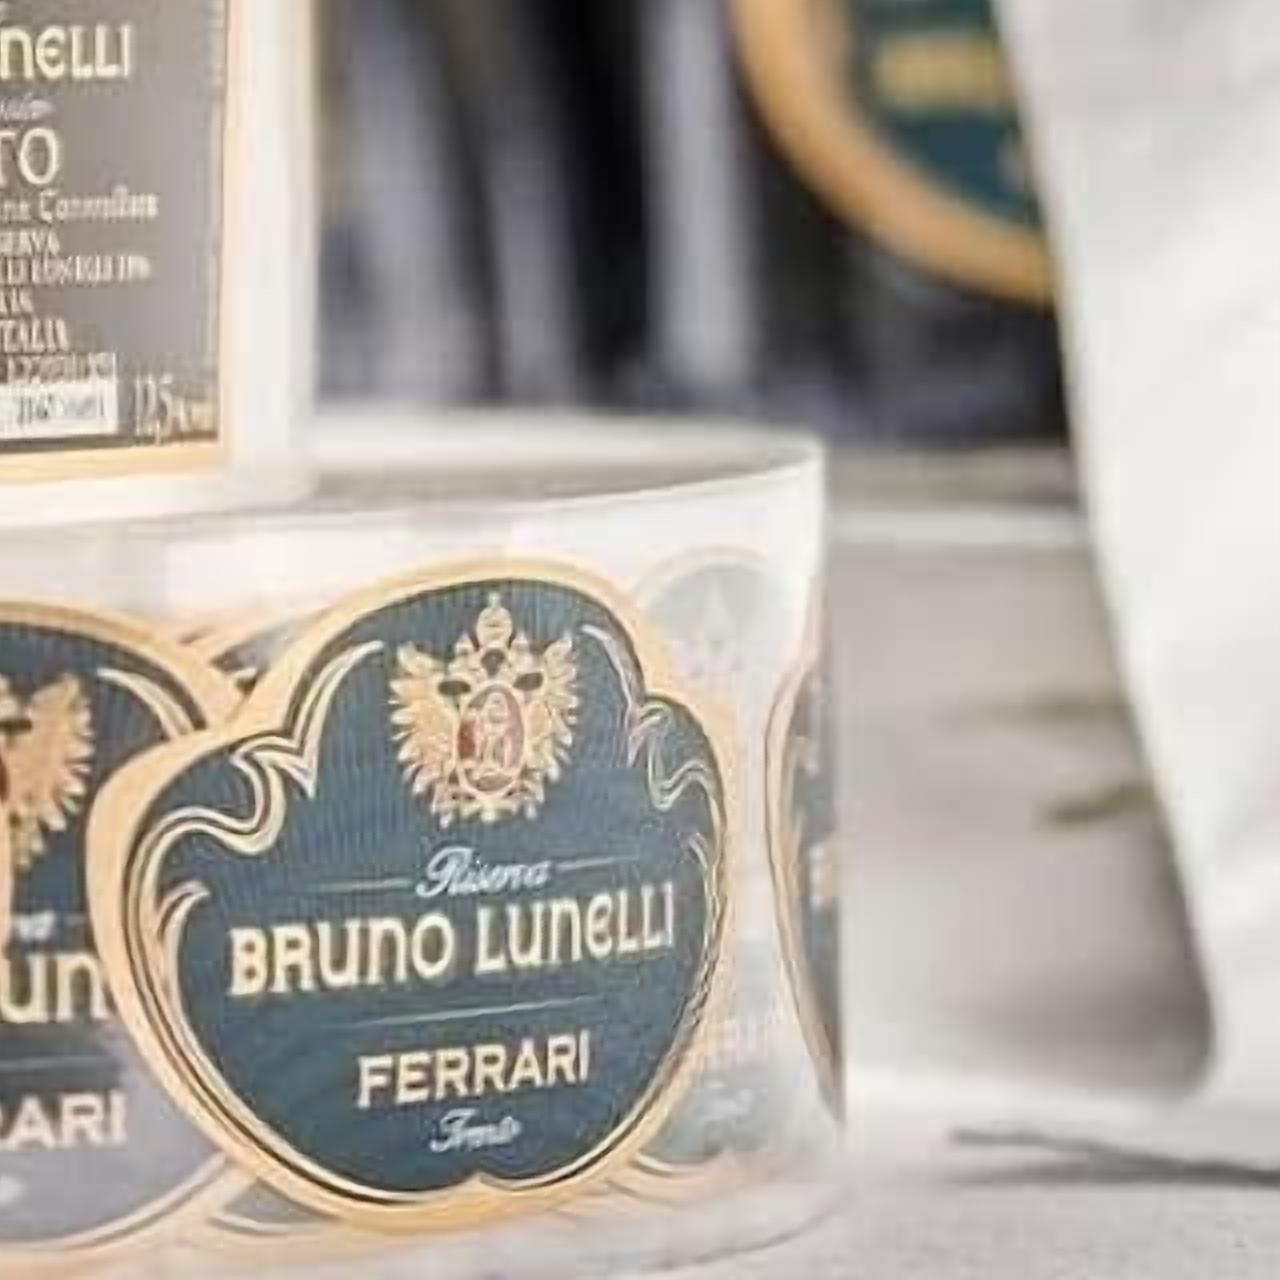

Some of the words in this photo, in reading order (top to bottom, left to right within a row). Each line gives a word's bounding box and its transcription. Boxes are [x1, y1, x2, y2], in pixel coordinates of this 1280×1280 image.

[229, 912, 455, 998] BRUNO
[474, 880, 675, 976] LUNELLI
[356, 1030, 591, 1110] FERRARI
